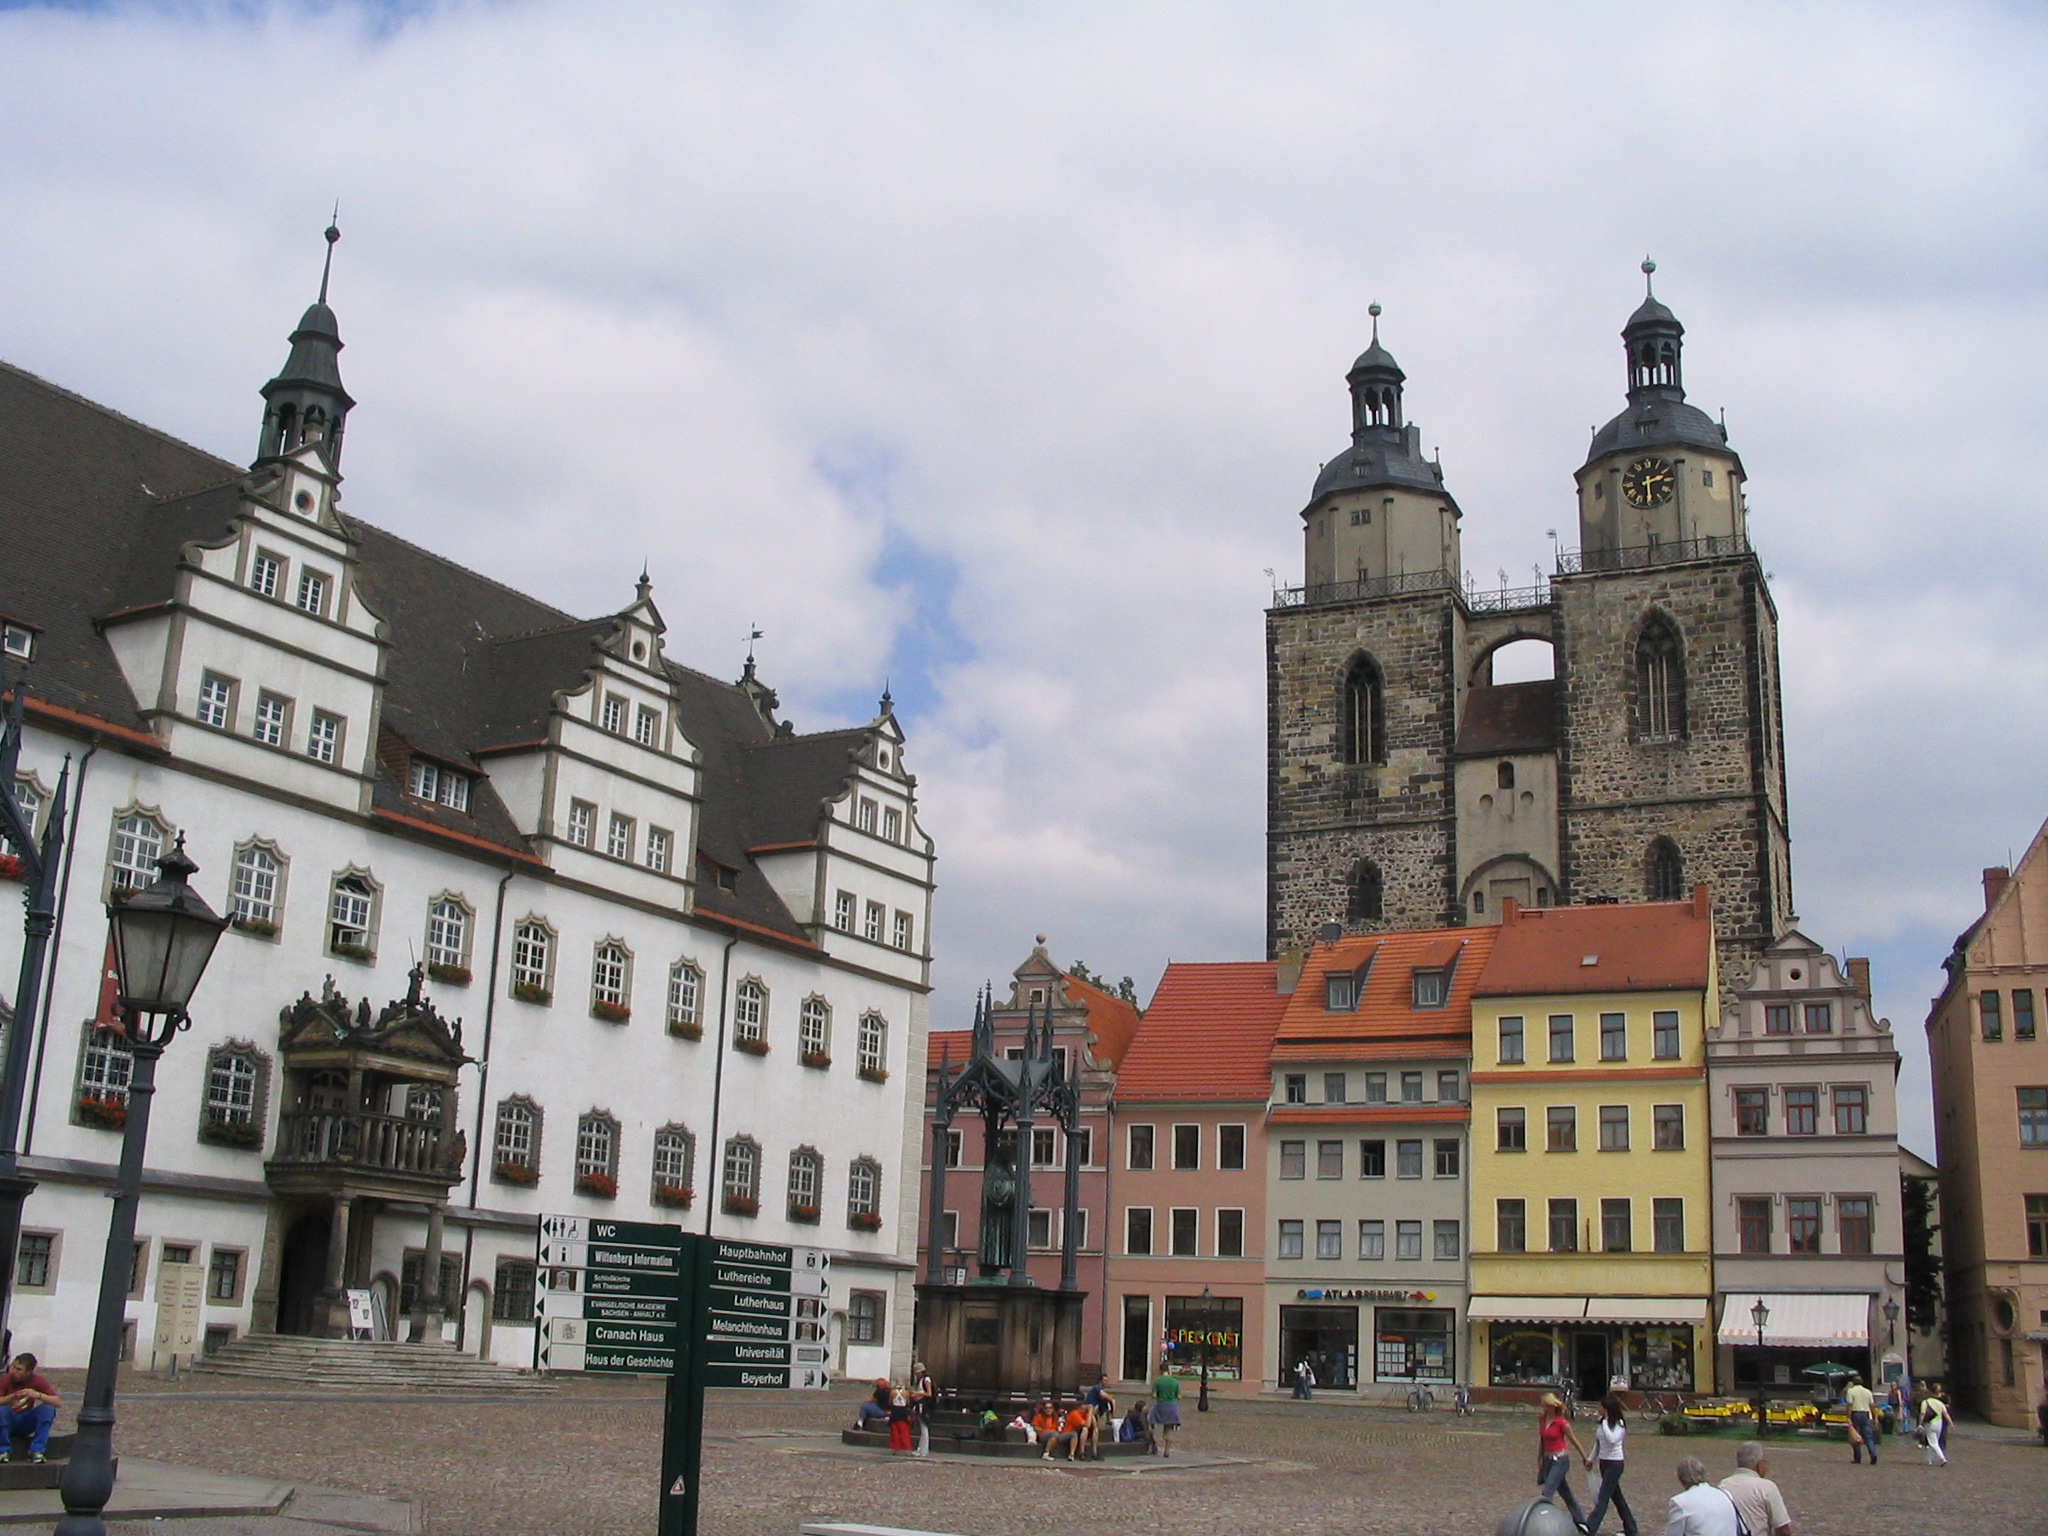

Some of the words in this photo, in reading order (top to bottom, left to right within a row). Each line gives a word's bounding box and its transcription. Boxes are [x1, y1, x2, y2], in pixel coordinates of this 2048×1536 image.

[596, 1224, 616, 1238] WC
[595, 1251, 633, 1266] Wittenberg
[634, 1252, 673, 1267] Information
[719, 1244, 787, 1263] Hauptbahnhof
[717, 1269, 772, 1285] Luthereiche
[734, 1294, 785, 1311] Lutherhaus
[1324, 1289, 1363, 1300] ATLAS
[595, 1327, 638, 1341] Cranach
[639, 1329, 665, 1343] Haus
[712, 1319, 783, 1337] Melanchthonhaus
[586, 1353, 609, 1366] Haus
[610, 1355, 625, 1367] der
[626, 1355, 675, 1369] Geschichte
[735, 1346, 785, 1360] Universität
[741, 1371, 784, 1387] Beyerhof
